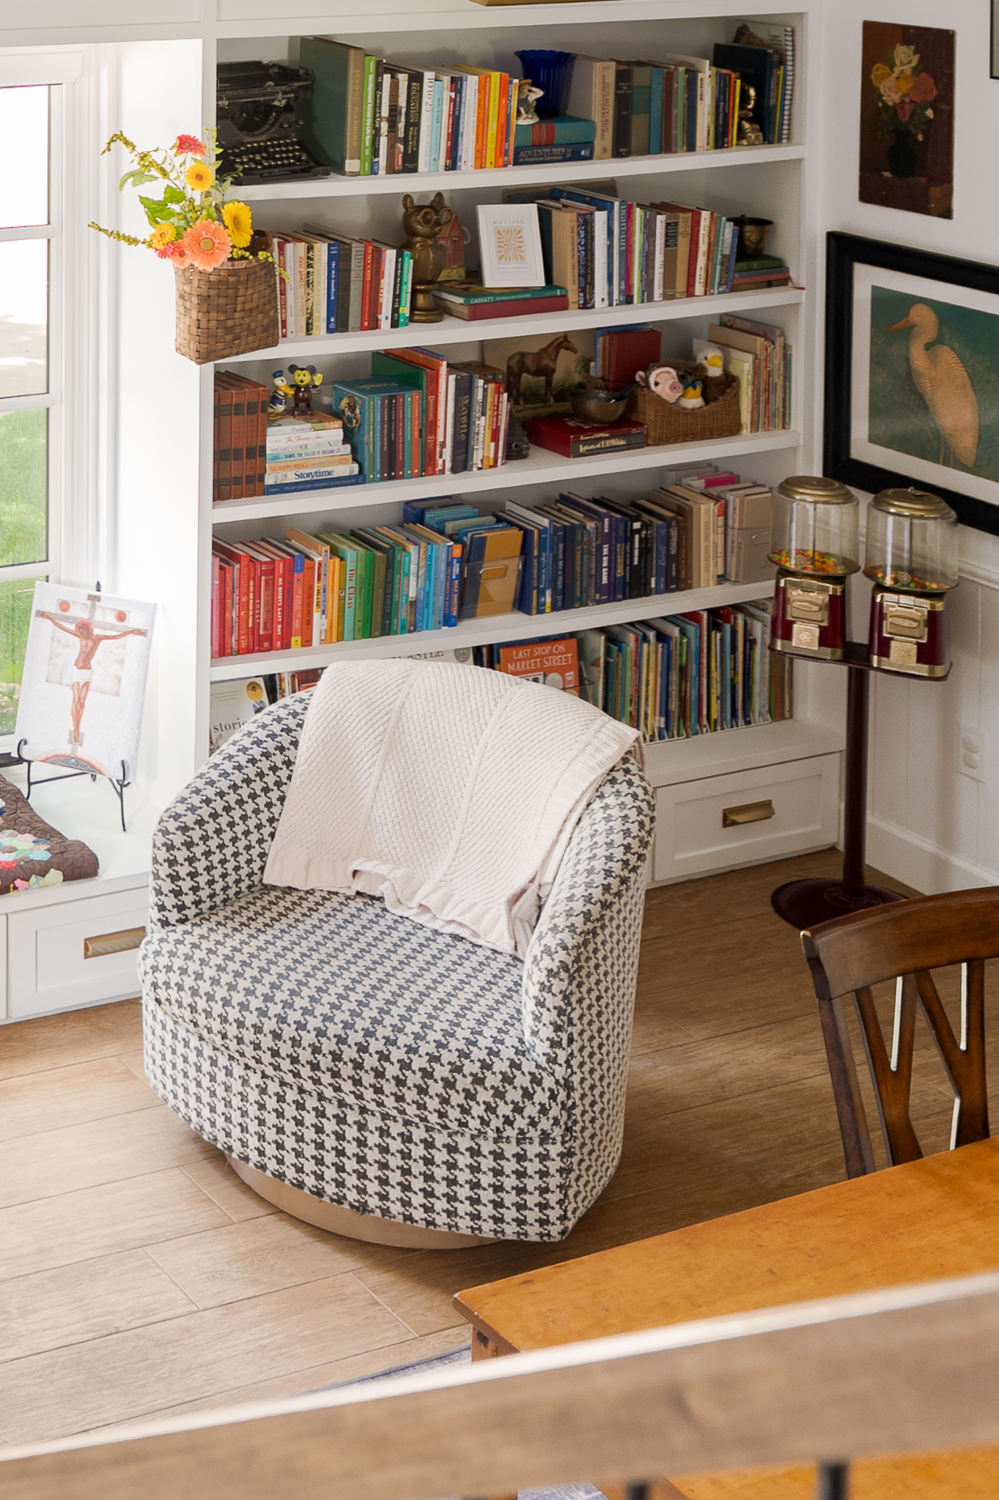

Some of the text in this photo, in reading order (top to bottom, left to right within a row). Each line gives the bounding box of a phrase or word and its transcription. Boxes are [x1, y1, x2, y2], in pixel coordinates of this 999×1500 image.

[519, 147, 566, 157] ADVENTURES
[470, 296, 494, 304] CASSATT
[294, 469, 334, 480] Storytime
[347, 568, 356, 609] The Class
[513, 643, 566, 660] LAST STOP ON
[507, 654, 573, 672] MARKET STREET
